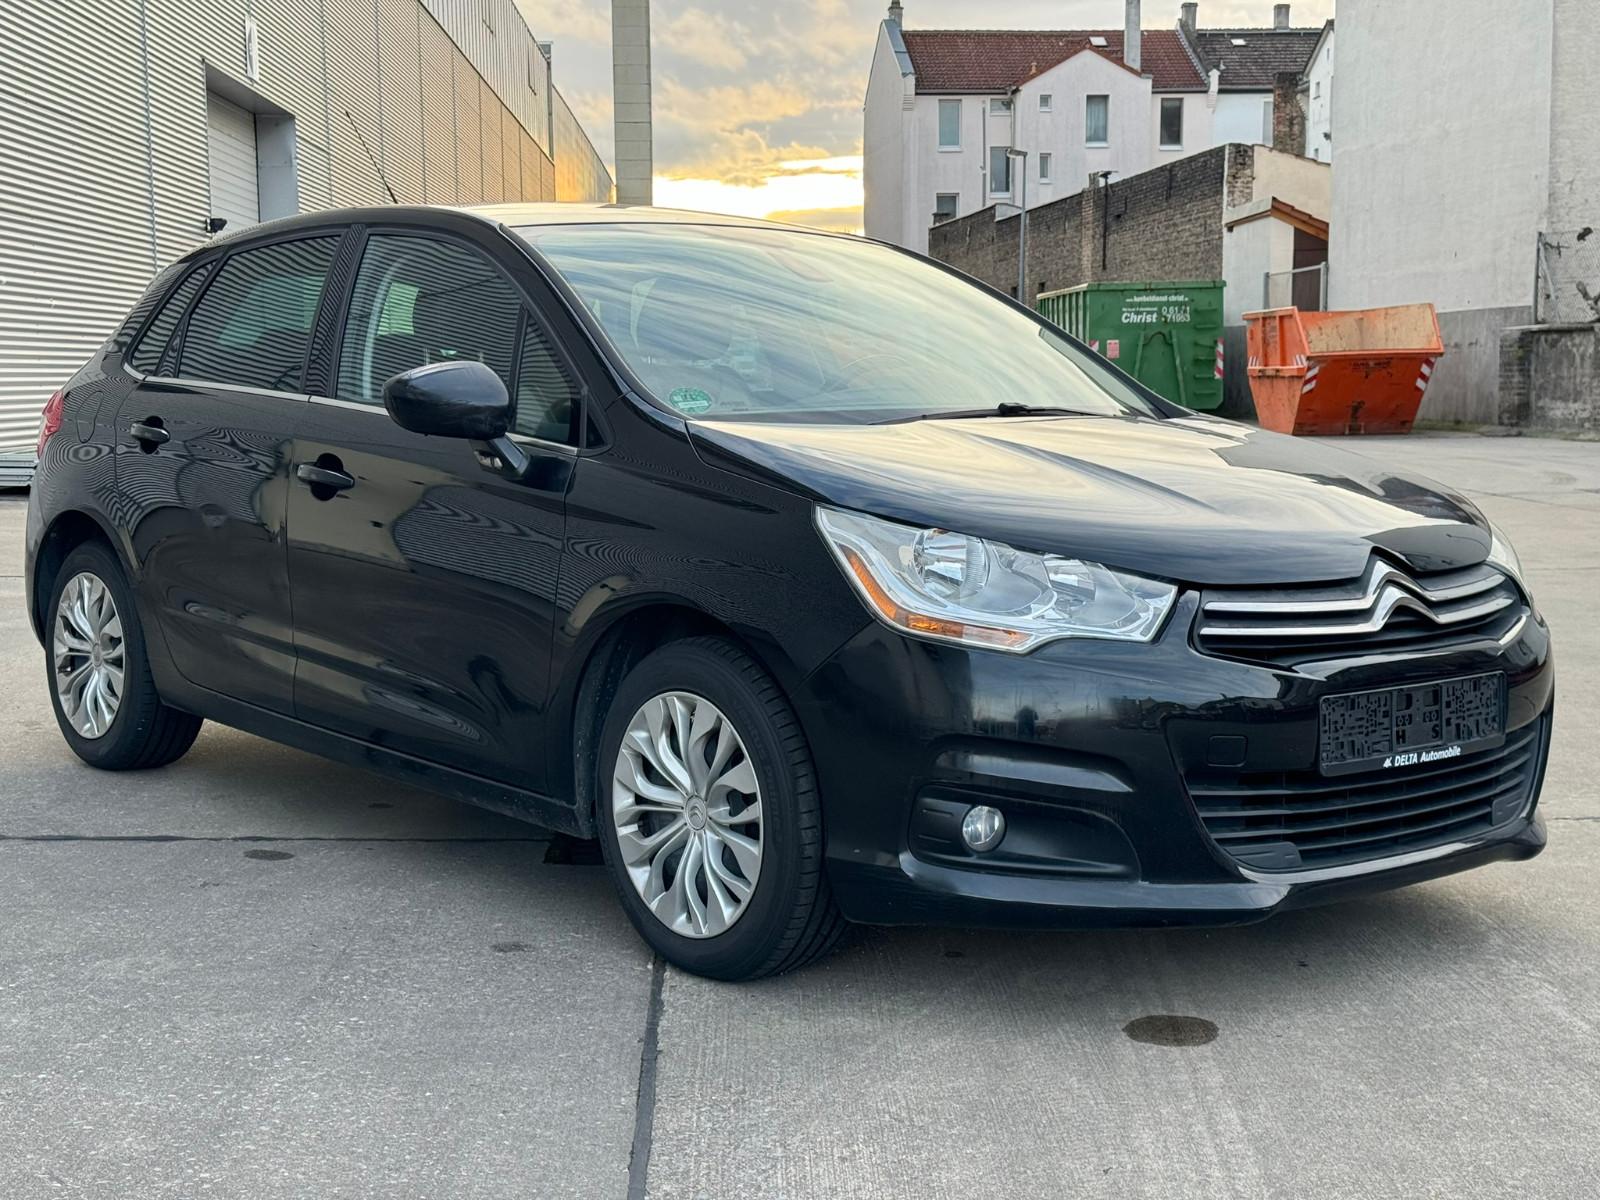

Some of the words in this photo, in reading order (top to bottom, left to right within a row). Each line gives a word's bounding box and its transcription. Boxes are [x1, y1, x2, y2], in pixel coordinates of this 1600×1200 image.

[1121, 312, 1158, 323] Christ
[1394, 753, 1418, 767] DELTA
[1420, 745, 1461, 763] Automobile
